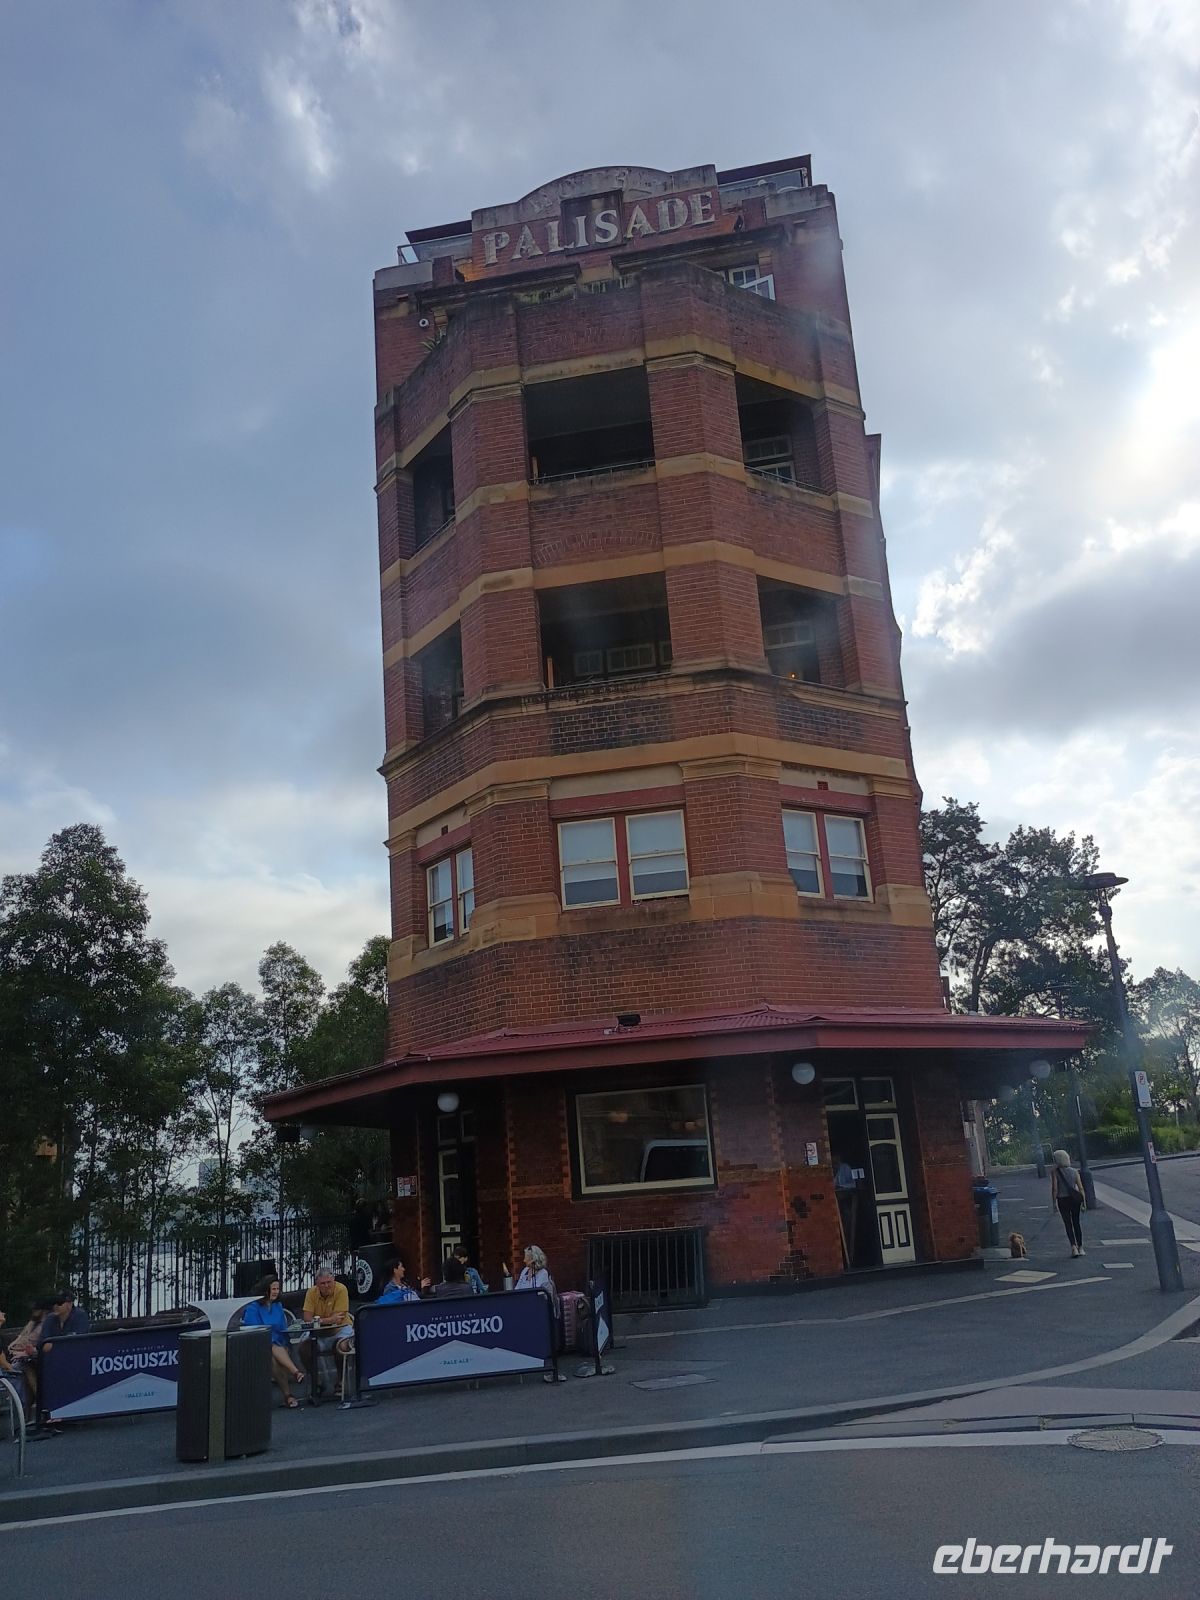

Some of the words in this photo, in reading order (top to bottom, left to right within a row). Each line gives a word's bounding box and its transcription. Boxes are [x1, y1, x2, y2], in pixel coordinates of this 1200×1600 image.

[482, 191, 715, 265] PALISADE
[406, 1315, 503, 1342] KOSCIUSZKO
[91, 1350, 179, 1375] KOSCIUSZK
